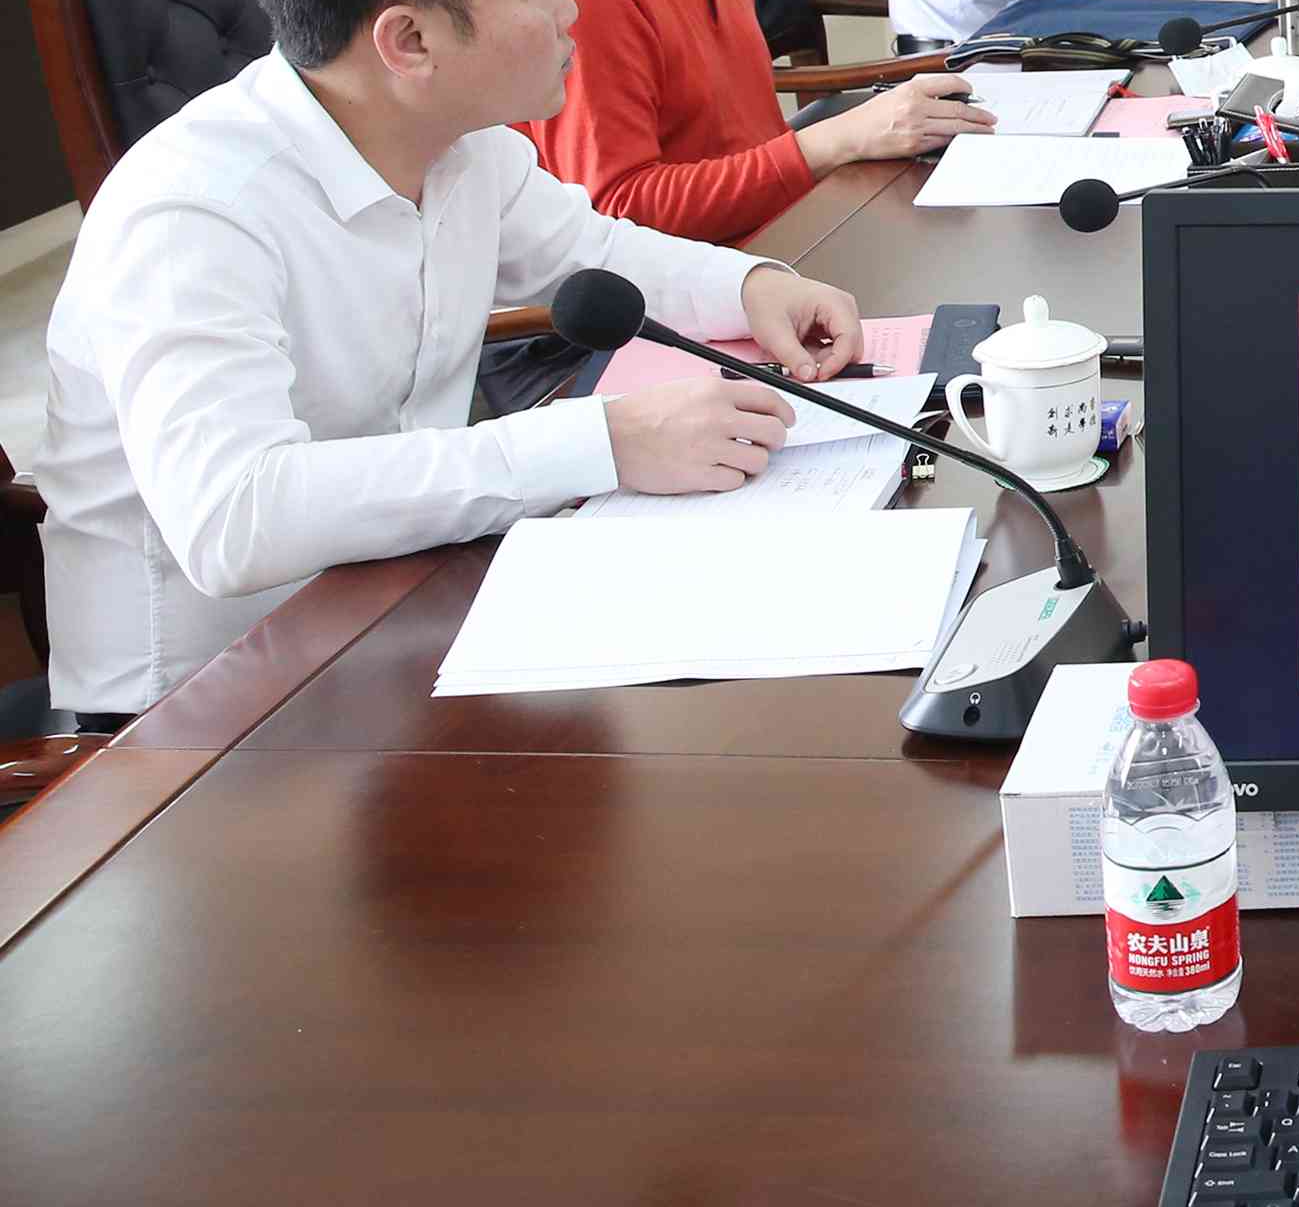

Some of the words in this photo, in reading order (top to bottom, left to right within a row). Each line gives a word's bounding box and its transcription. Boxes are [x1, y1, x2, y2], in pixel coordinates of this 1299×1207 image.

[1127, 929, 1210, 954] 农夫山泉
[1171, 949, 1210, 966] SPRING
[1281, 1118, 1294, 1126] Q
[1288, 1144, 1299, 1153] A
